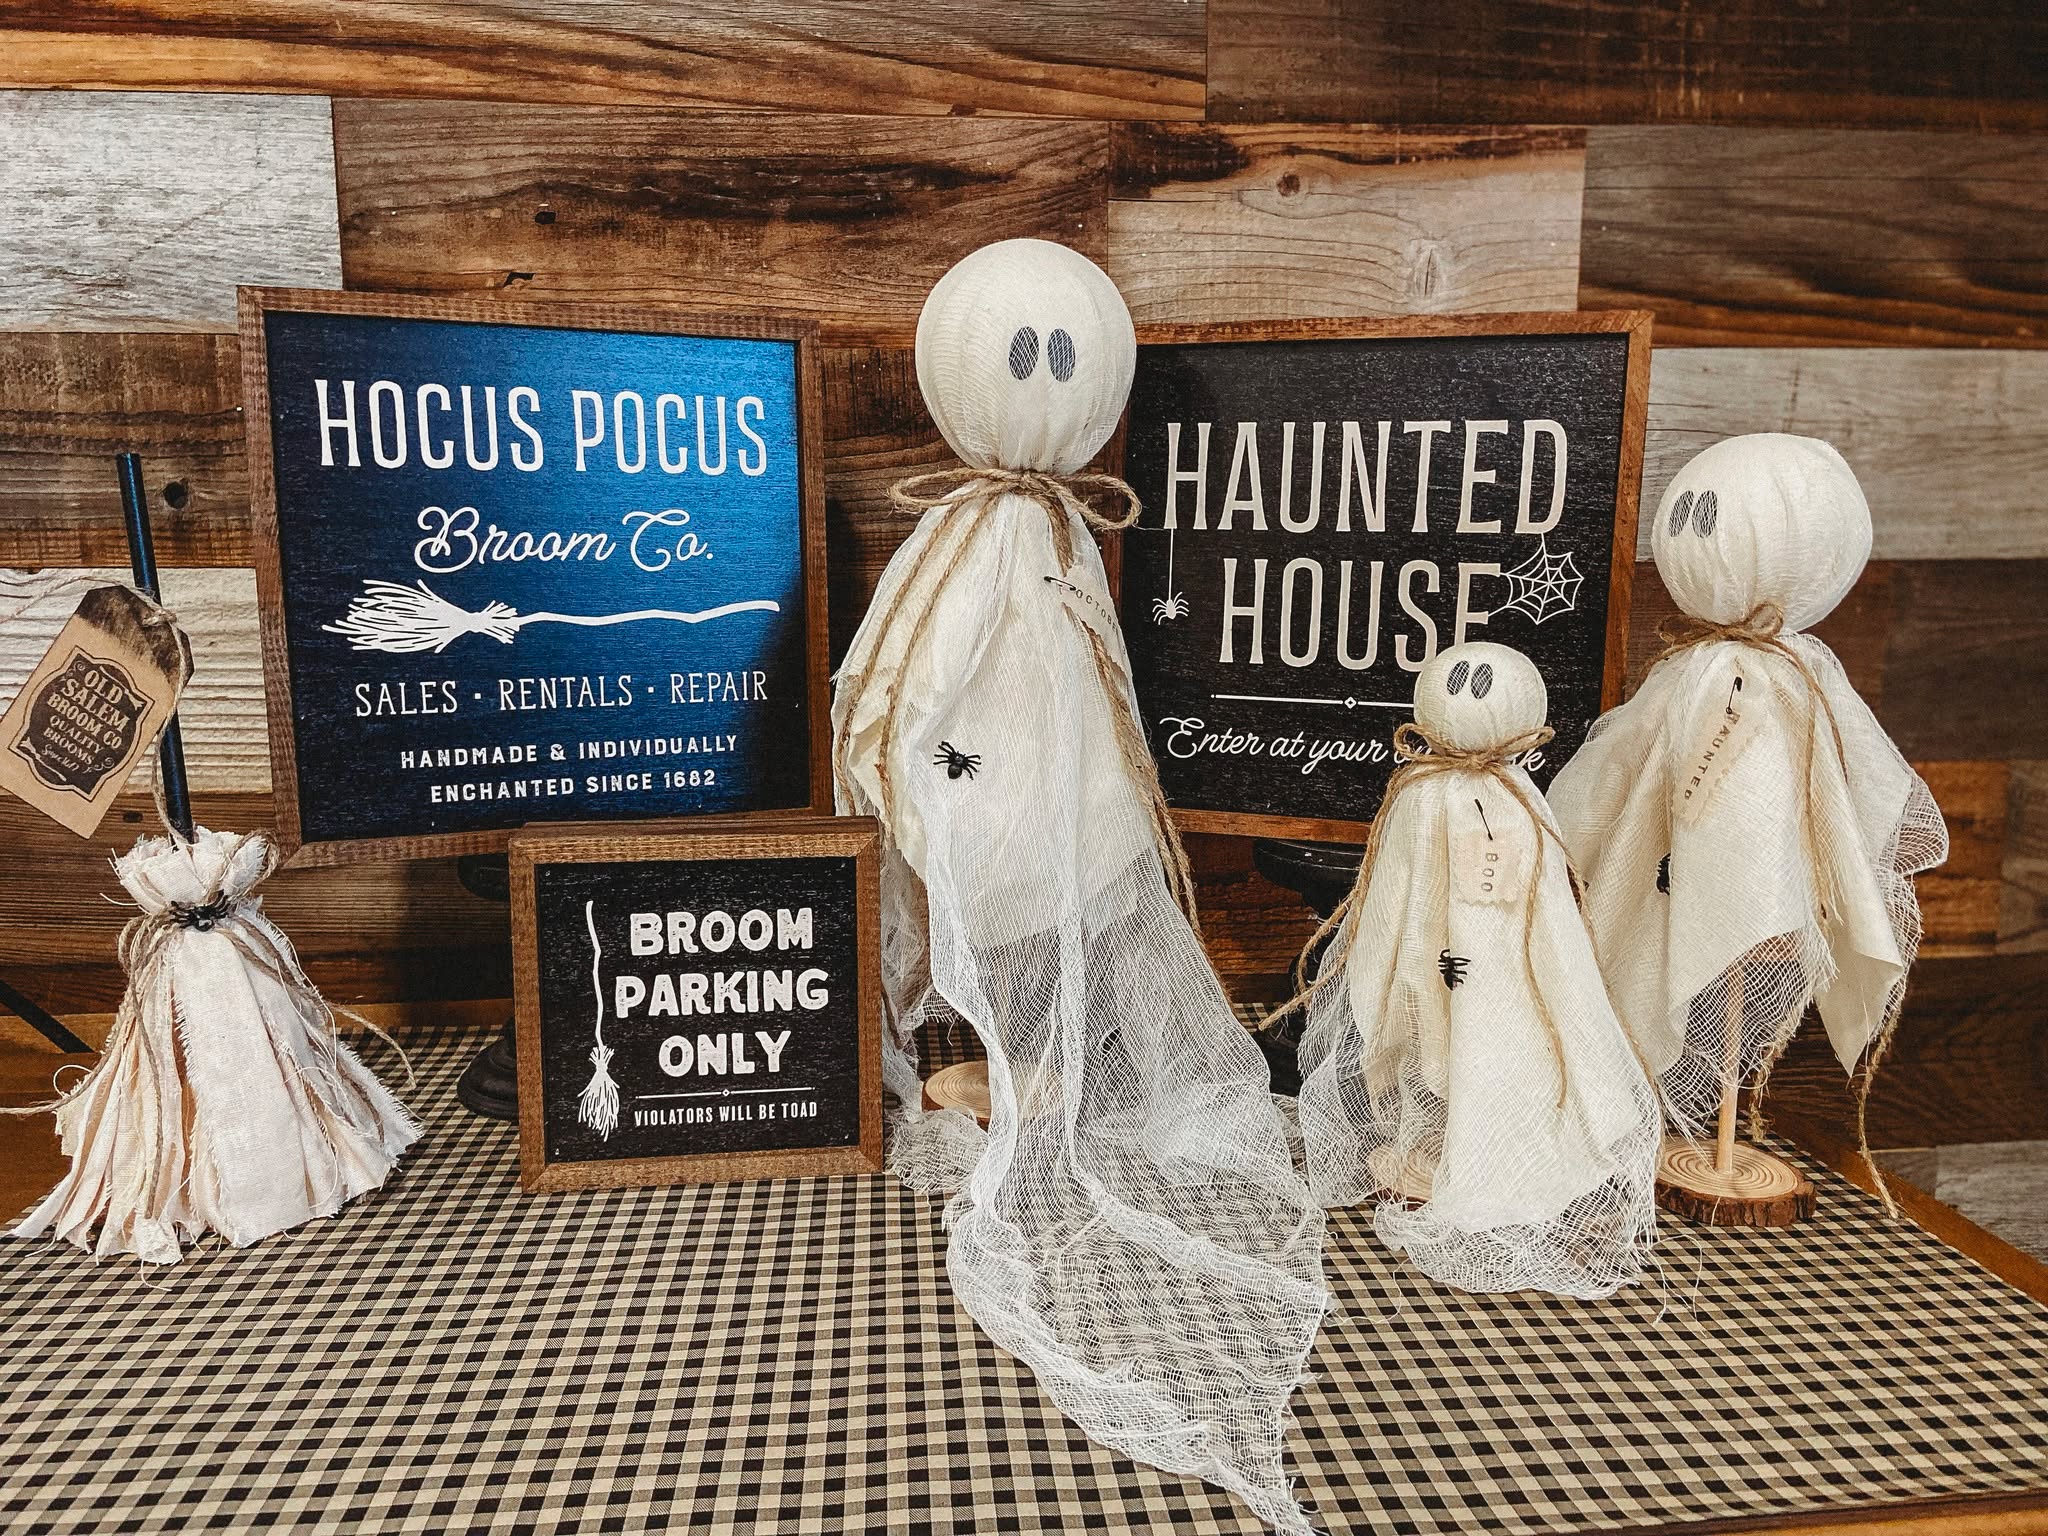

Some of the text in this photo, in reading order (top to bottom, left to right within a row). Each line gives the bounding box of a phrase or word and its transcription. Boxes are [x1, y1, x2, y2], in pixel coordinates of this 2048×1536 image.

[314, 379, 768, 476] HOCUS POCUS
[1164, 419, 1568, 534] HAUNTED
[414, 506, 714, 573] Broom Co.
[61, 679, 130, 733] SALEM
[84, 670, 123, 704] OLD
[355, 670, 768, 717] SALES RENTALS REPAIR
[47, 692, 122, 749] BROOM CO
[50, 715, 104, 754] QUALITY
[44, 727, 94, 765] BROOMS
[400, 735, 738, 769] HANDMADE & INDIVIDUALLY
[1159, 717, 1265, 759] Enter
[1269, 730, 1304, 758] at
[1301, 737, 1389, 775] your
[431, 769, 715, 803] ENCHANTED SINCE 1682
[1481, 852, 1499, 892] BOO
[630, 908, 813, 956] BROOM
[616, 968, 829, 1018] PARKING
[659, 1031, 791, 1077] ONLY
[634, 1101, 817, 1127] VIOLATORS WILL BE TOAD
